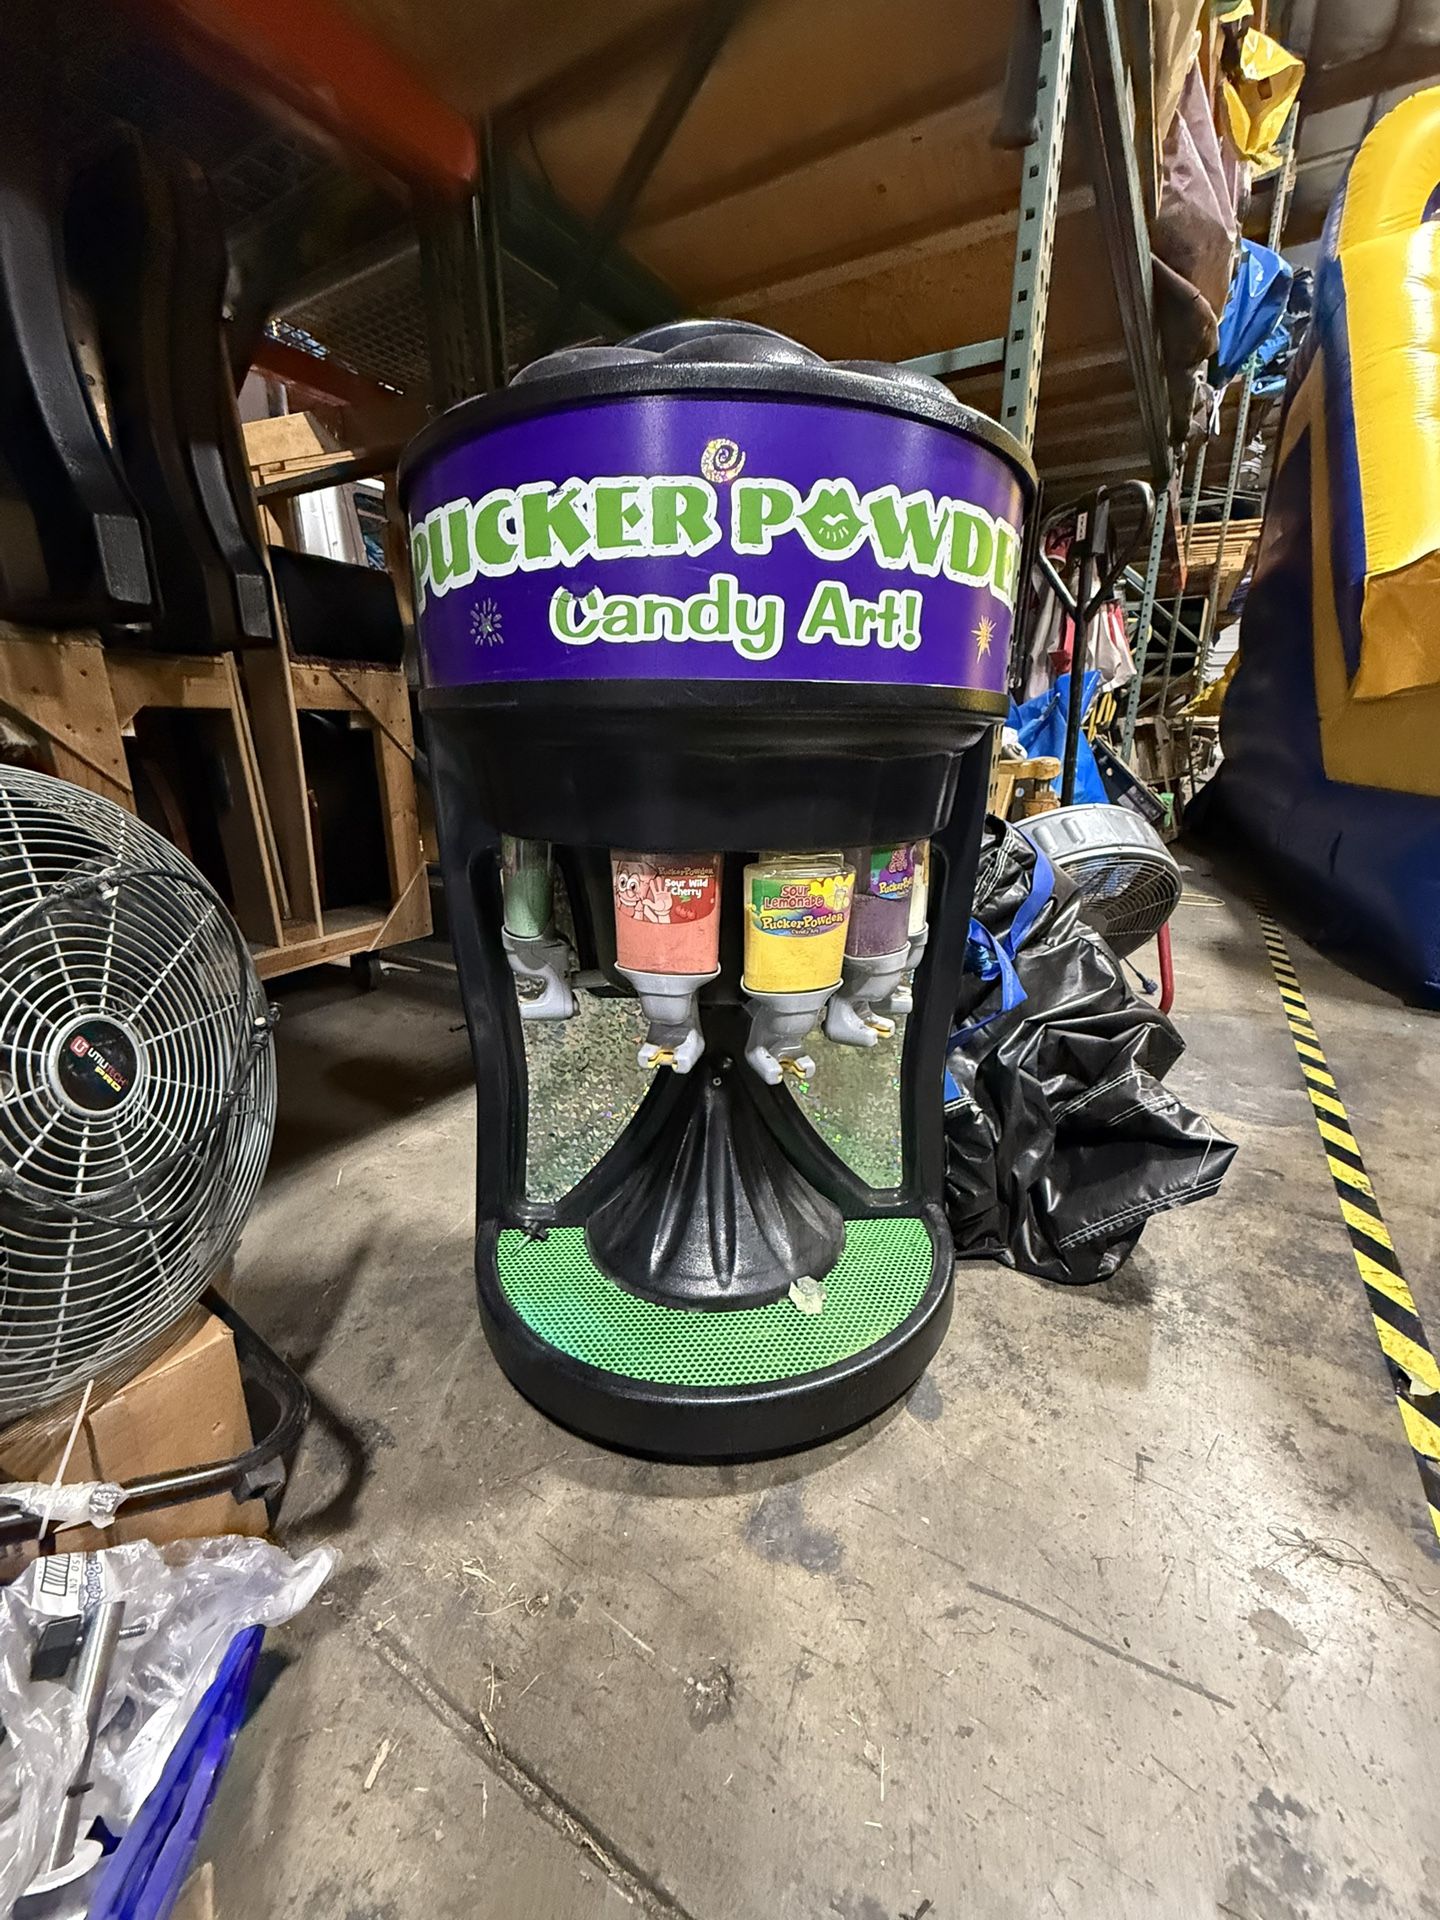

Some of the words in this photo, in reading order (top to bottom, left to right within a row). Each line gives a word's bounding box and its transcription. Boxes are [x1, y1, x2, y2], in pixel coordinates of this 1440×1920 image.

[410, 476, 720, 615] PUCKER
[732, 477, 1021, 615] POWDE
[549, 573, 784, 660] Candy
[798, 579, 922, 650] Art!
[664, 878, 686, 888] Sour
[688, 878, 709, 888] Wild
[671, 887, 702, 899] Cherry
[94, 1066, 122, 1092] PRO
